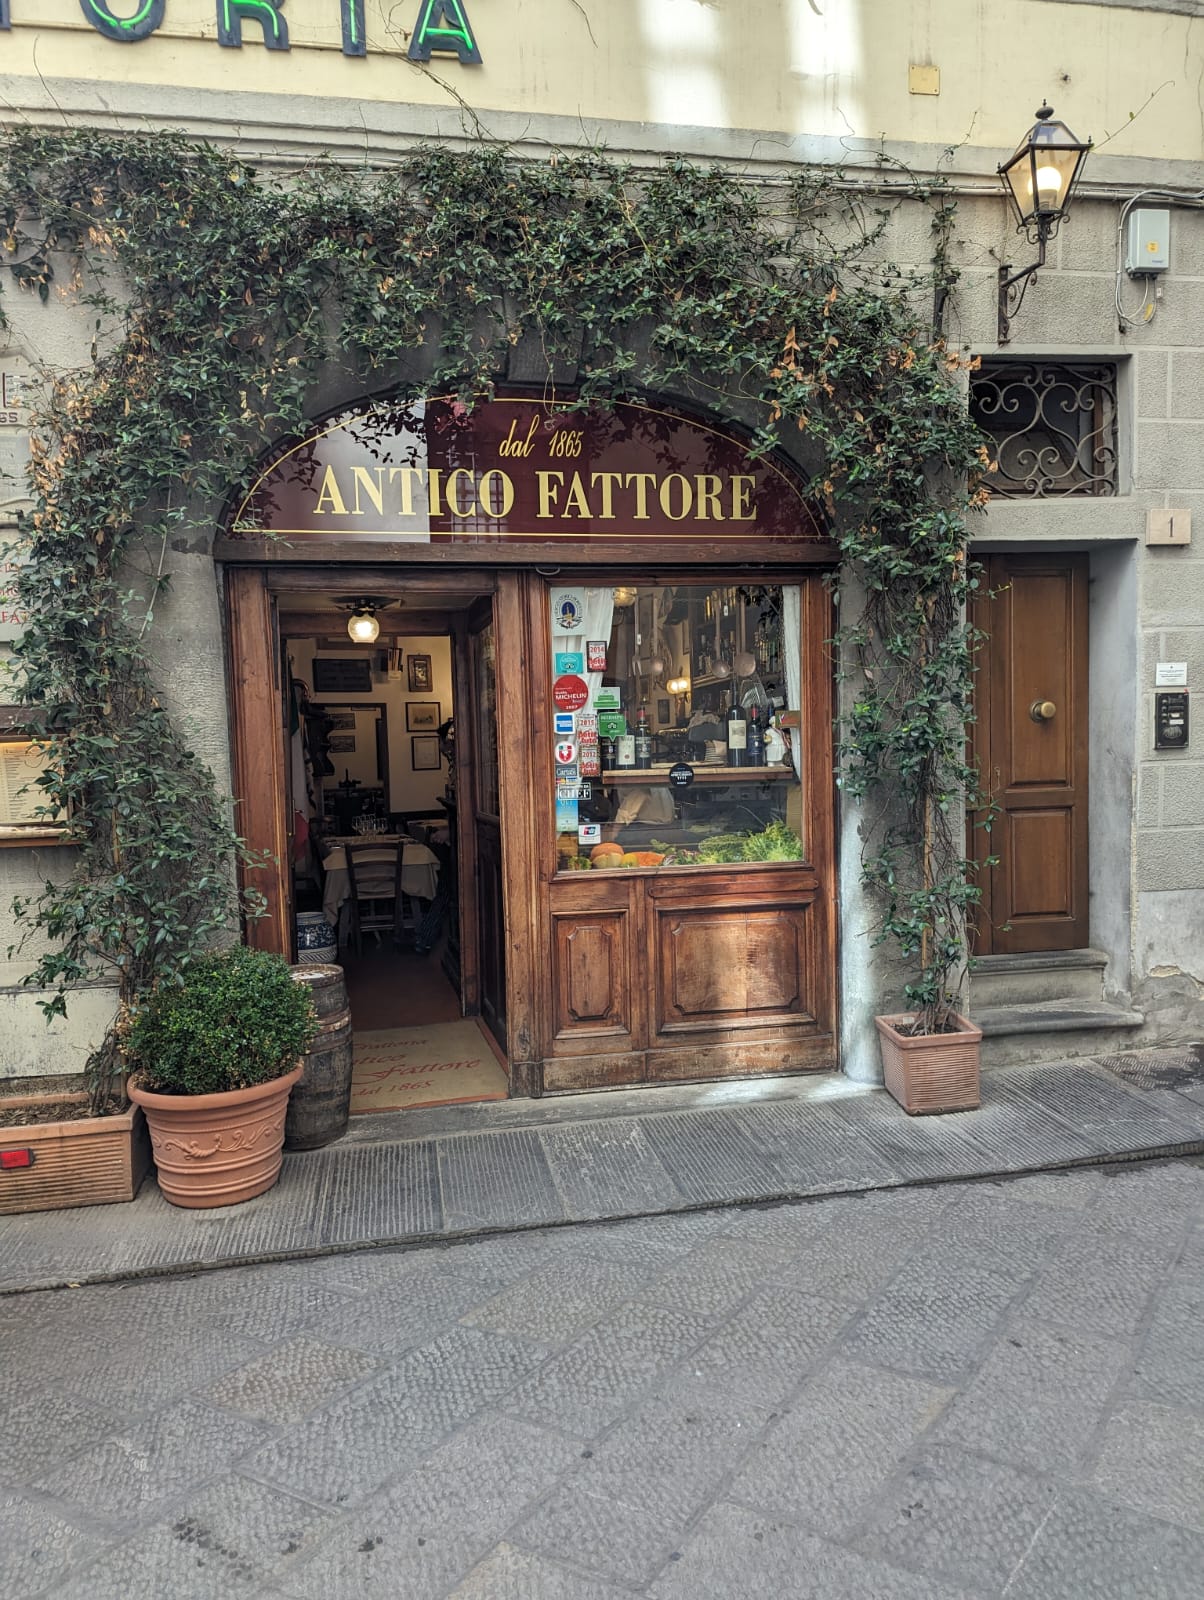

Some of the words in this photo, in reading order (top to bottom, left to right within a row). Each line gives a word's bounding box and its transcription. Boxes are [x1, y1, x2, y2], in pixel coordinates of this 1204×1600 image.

[498, 414, 540, 458] dal
[548, 429, 583, 458] 1865
[312, 464, 515, 519] ANTICO
[535, 470, 759, 522] FATTORE
[1167, 516, 1175, 538] 1
[555, 692, 587, 701] MICHELIN
[389, 1079, 435, 1093] 1865
